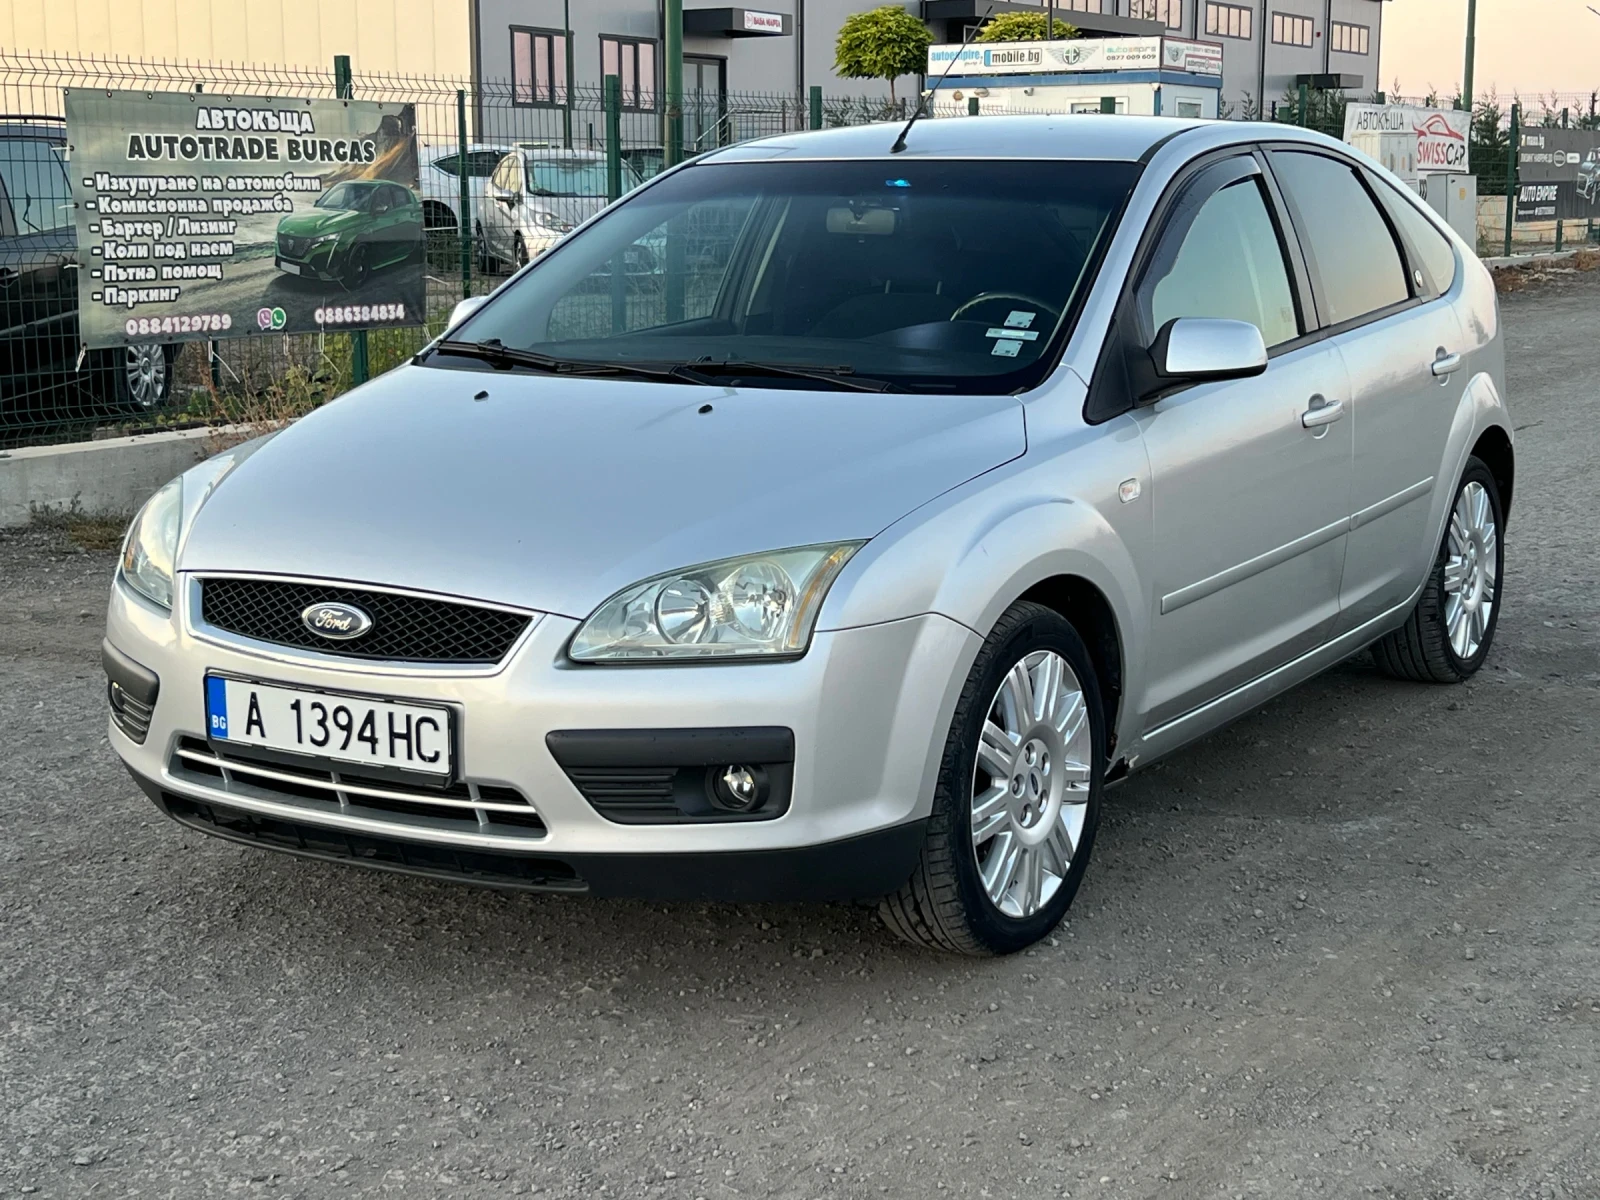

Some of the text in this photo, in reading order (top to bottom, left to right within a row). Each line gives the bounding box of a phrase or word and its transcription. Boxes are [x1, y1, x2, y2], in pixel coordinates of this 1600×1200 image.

[992, 49, 1040, 63] mobile.bg
[196, 107, 315, 136] АВТОКЪЩА
[127, 133, 376, 163] AUTOTRADE BURGAS
[202, 177, 222, 191] на
[226, 173, 321, 191] автомобили
[1519, 185, 1558, 202] AUTO EMPIRE
[212, 194, 293, 217] продажба
[177, 218, 236, 235] Лизинг
[153, 243, 186, 259] под
[190, 242, 234, 257] наем
[161, 264, 222, 280] помощ
[125, 303, 405, 335] 0884129789 0886384834
[314, 608, 351, 632] Ford
[211, 714, 227, 730] BG
[245, 691, 267, 738] A
